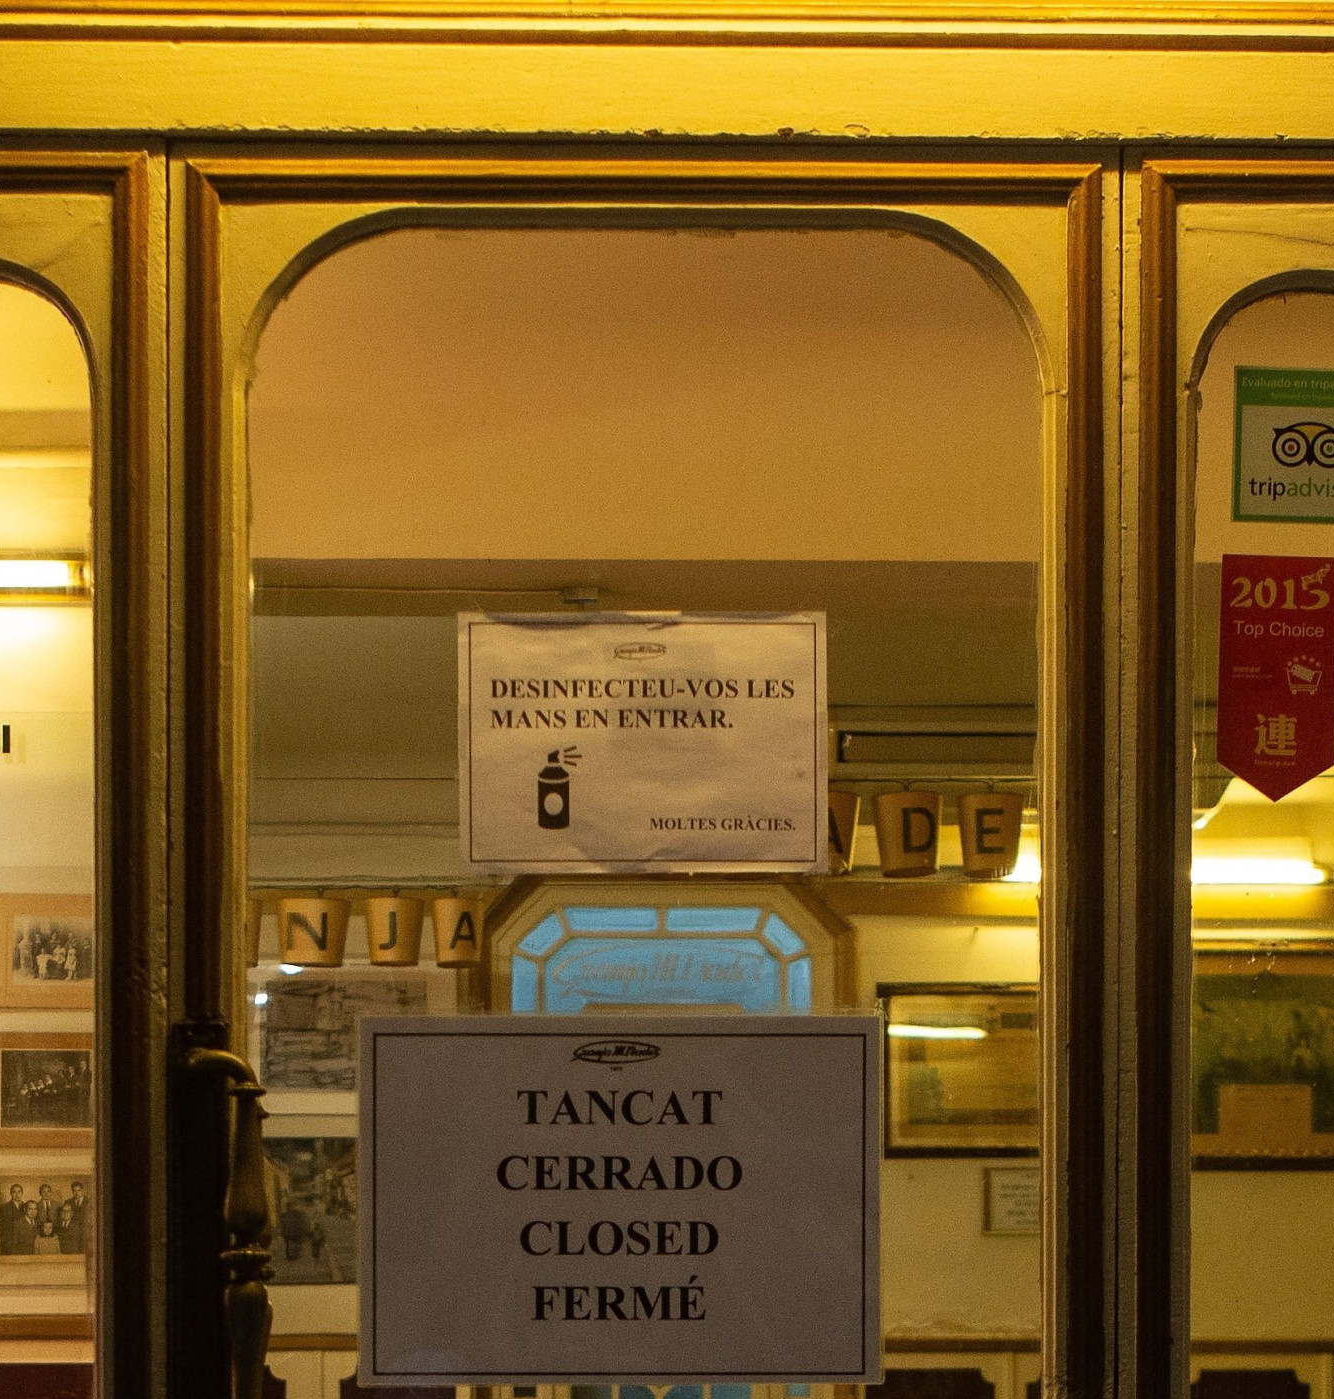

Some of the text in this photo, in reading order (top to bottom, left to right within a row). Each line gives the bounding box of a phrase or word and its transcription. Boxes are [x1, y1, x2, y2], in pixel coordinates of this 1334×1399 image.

[1242, 376, 1291, 389] Evaluado
[1293, 380, 1309, 390] en
[1230, 564, 1330, 610] 2015
[1233, 620, 1325, 638] Top Choice
[490, 678, 795, 699] DESINFECTEU-VOS LES
[490, 708, 734, 729] MANS EN ENTRAR.
[649, 814, 797, 832] MOLTES GRÀCIES.
[287, 911, 477, 950] NJA
[517, 1090, 723, 1126] TANCAT
[496, 1155, 743, 1191] CERRADO
[519, 1220, 719, 1256] CLOSED
[531, 1276, 706, 1321] FERMÉ
